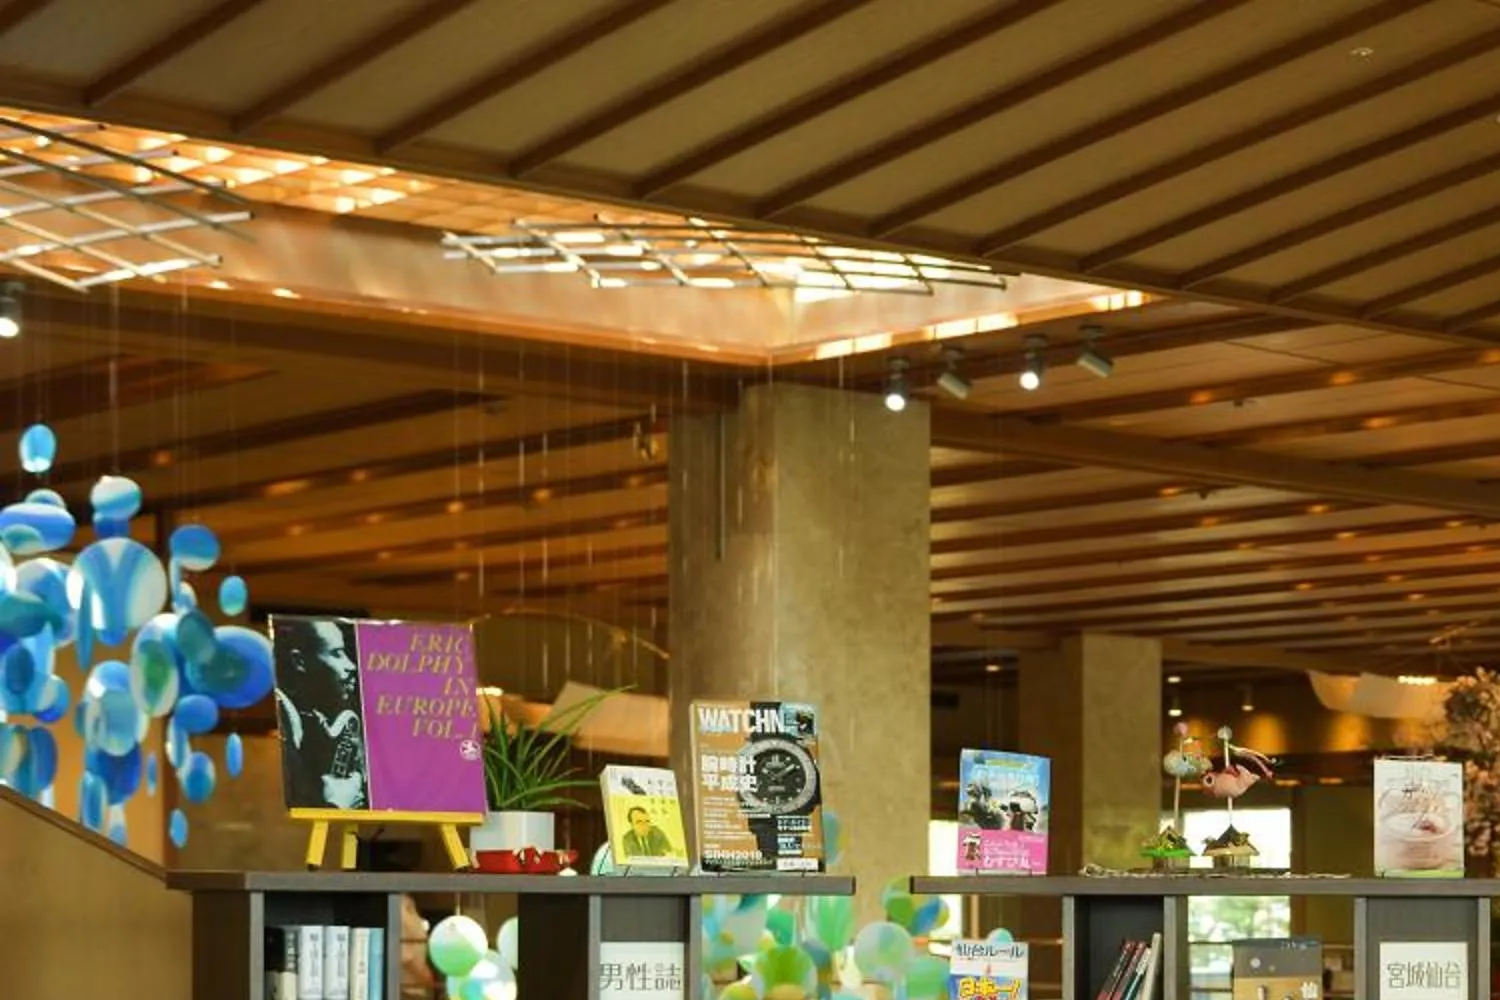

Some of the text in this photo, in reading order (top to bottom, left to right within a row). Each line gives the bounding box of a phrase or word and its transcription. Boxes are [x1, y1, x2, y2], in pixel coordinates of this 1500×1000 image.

[699, 708, 786, 734] WATCHN
[956, 943, 1025, 959] 仙台ルール
[599, 963, 682, 991] 男性誌
[1387, 961, 1462, 990] 宮城仙台
